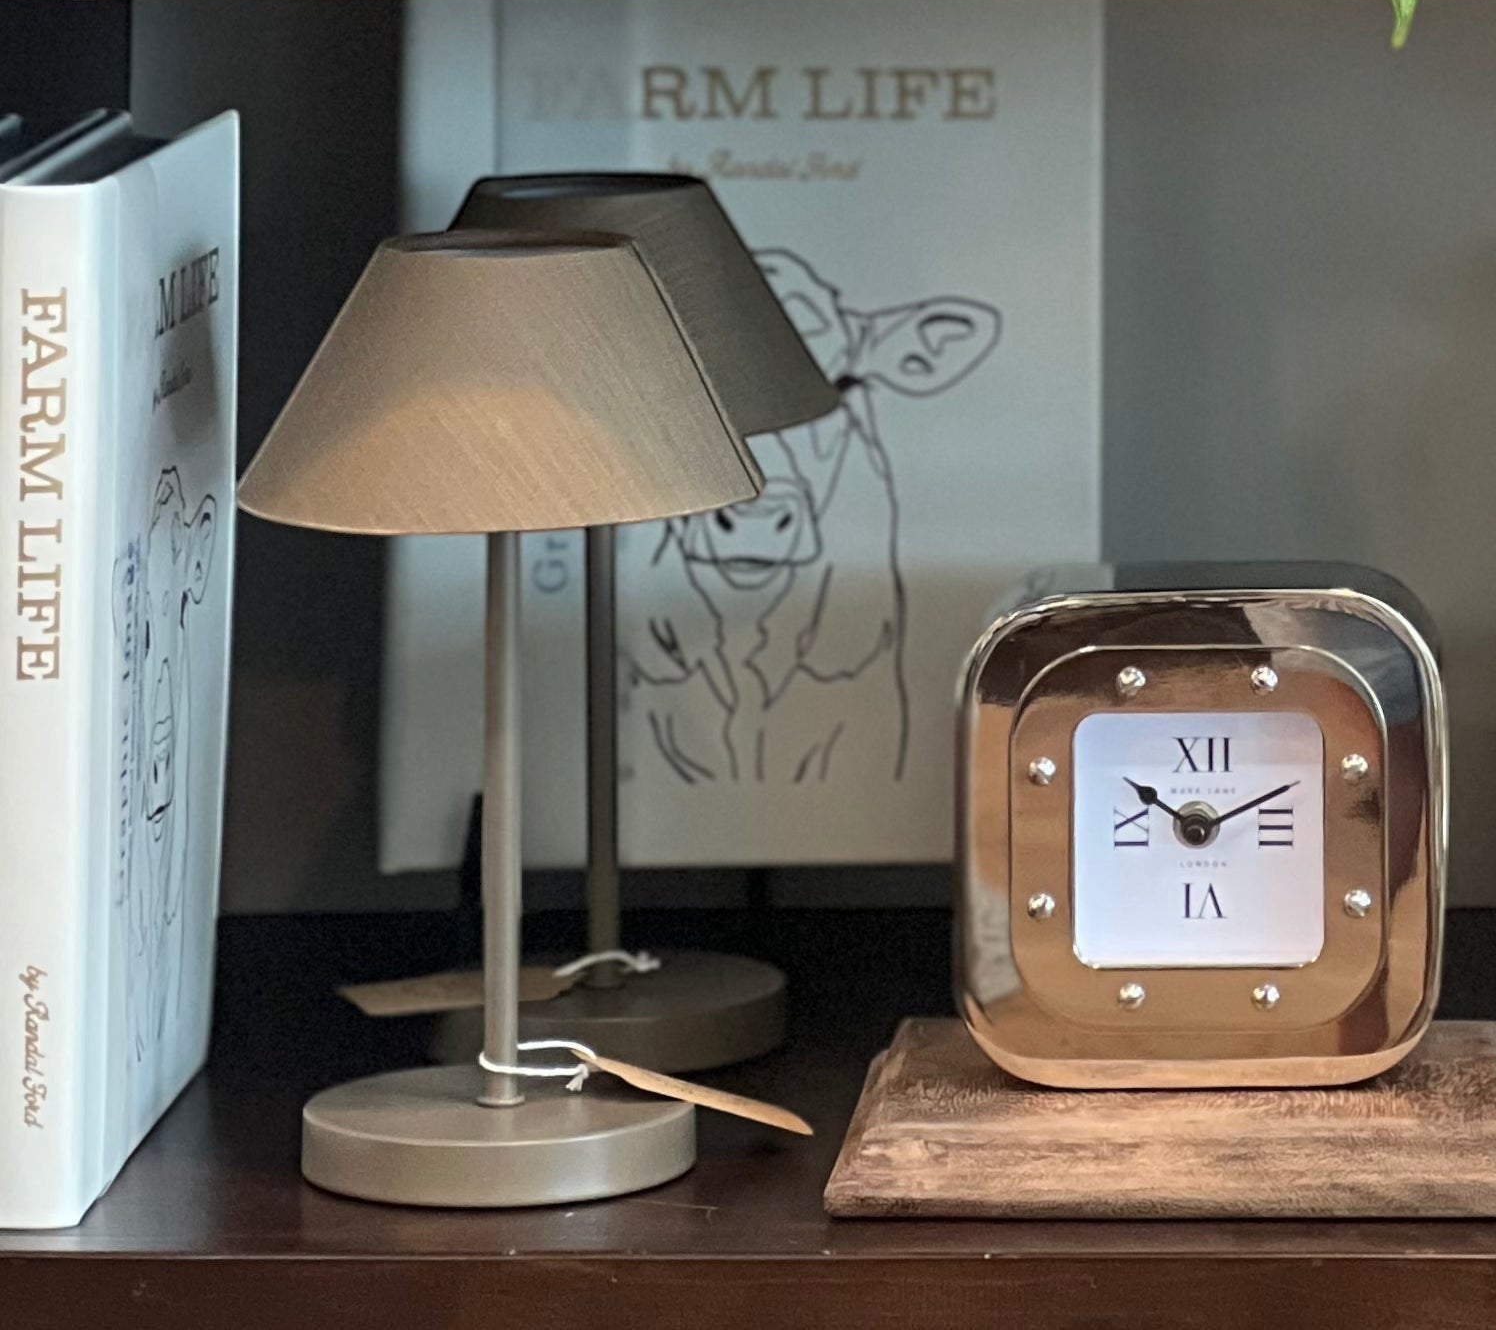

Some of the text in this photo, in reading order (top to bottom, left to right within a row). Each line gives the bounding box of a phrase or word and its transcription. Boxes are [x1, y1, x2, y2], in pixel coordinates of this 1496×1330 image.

[802, 66, 997, 122] LIFE
[15, 286, 68, 681] FARM LIFE
[1172, 736, 1233, 774] XII
[18, 964, 51, 1130] by Randal Ford
